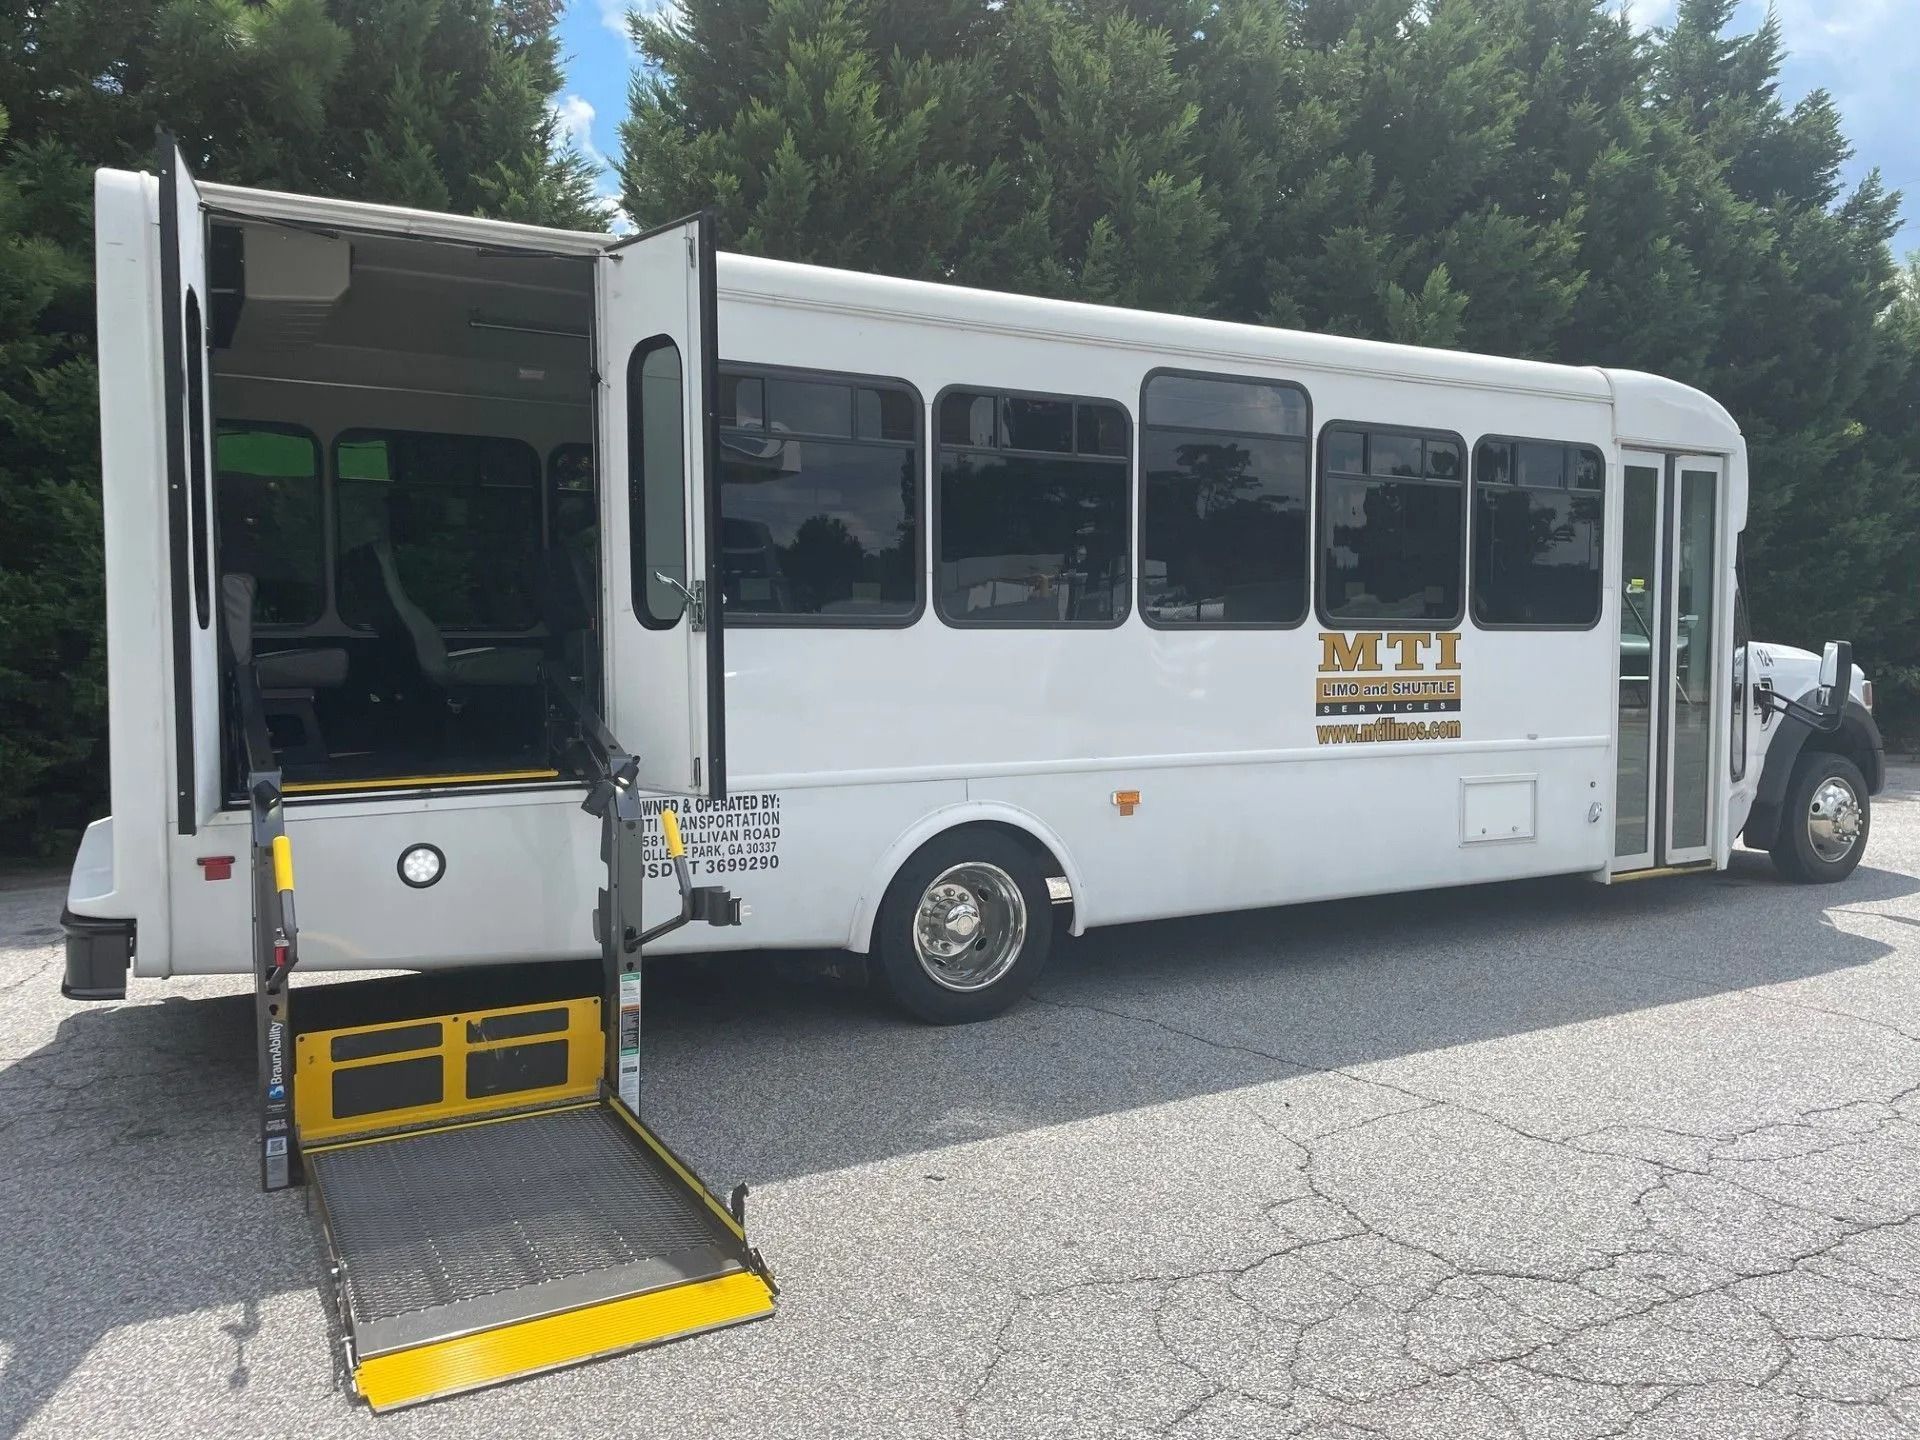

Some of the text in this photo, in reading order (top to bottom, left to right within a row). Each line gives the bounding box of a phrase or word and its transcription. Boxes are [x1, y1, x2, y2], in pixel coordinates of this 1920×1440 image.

[1318, 632, 1461, 672] MTI
[1756, 649, 1775, 667] 124
[1323, 681, 1455, 697] LIMO and SHUTTLE
[1323, 702, 1446, 713] SERVICES
[1316, 717, 1461, 744] www.mtilimos.com
[641, 794, 780, 816] WNED & OPERATED BY:
[643, 811, 780, 833] TI ANSPORTATION
[642, 827, 781, 848] 581 ULLIVAN ROAD
[642, 842, 777, 862] OLLEE PARK, GA 30337
[642, 855, 780, 879] SDT 3699290
[269, 1020, 284, 1085] BraunAbility
